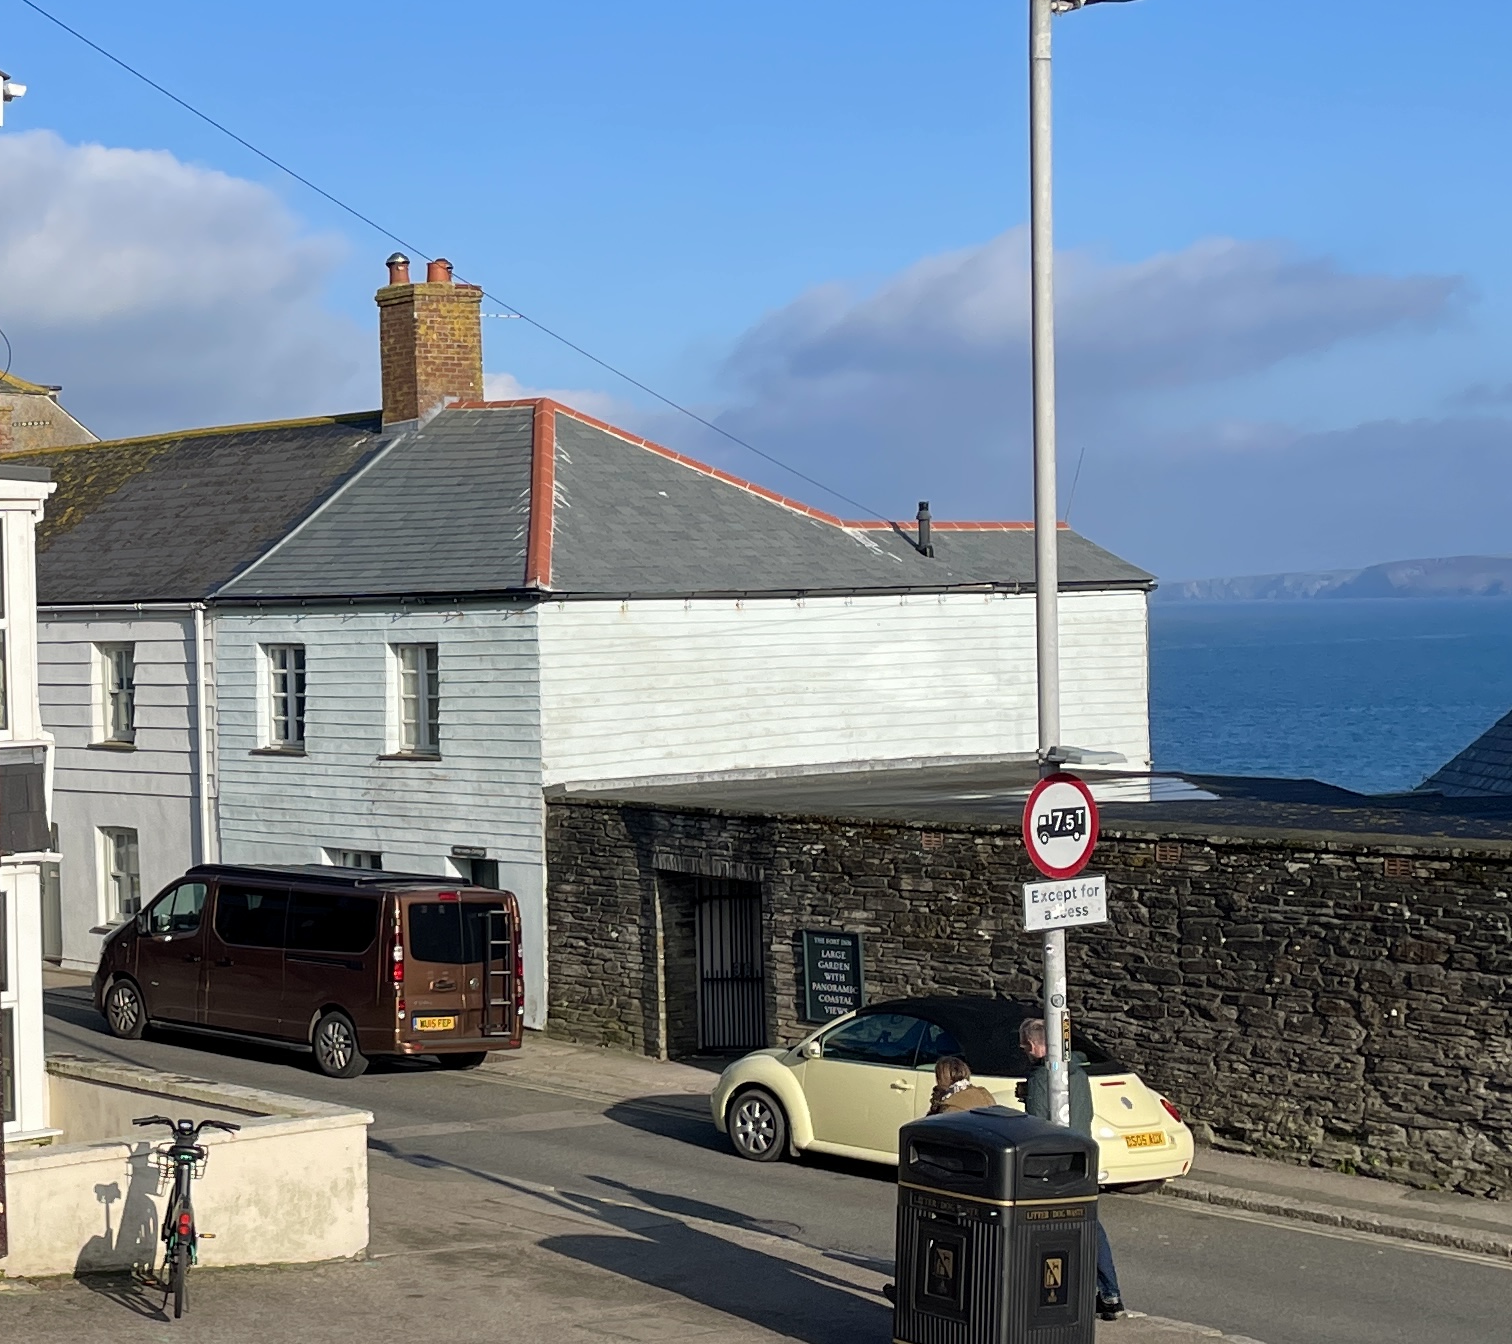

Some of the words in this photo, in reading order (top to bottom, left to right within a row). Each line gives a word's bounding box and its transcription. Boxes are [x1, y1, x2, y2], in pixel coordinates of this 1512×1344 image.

[1031, 886, 1077, 904] Except
[1081, 883, 1100, 898] for
[821, 950, 846, 959] LARGE
[818, 961, 849, 970] GARDEN
[824, 972, 845, 982] WITH
[812, 982, 858, 994] PANORAMIC
[818, 994, 853, 1005] COASTAL
[824, 1006, 848, 1014] VIEWS
[1026, 1210, 1049, 1220] LITTER
